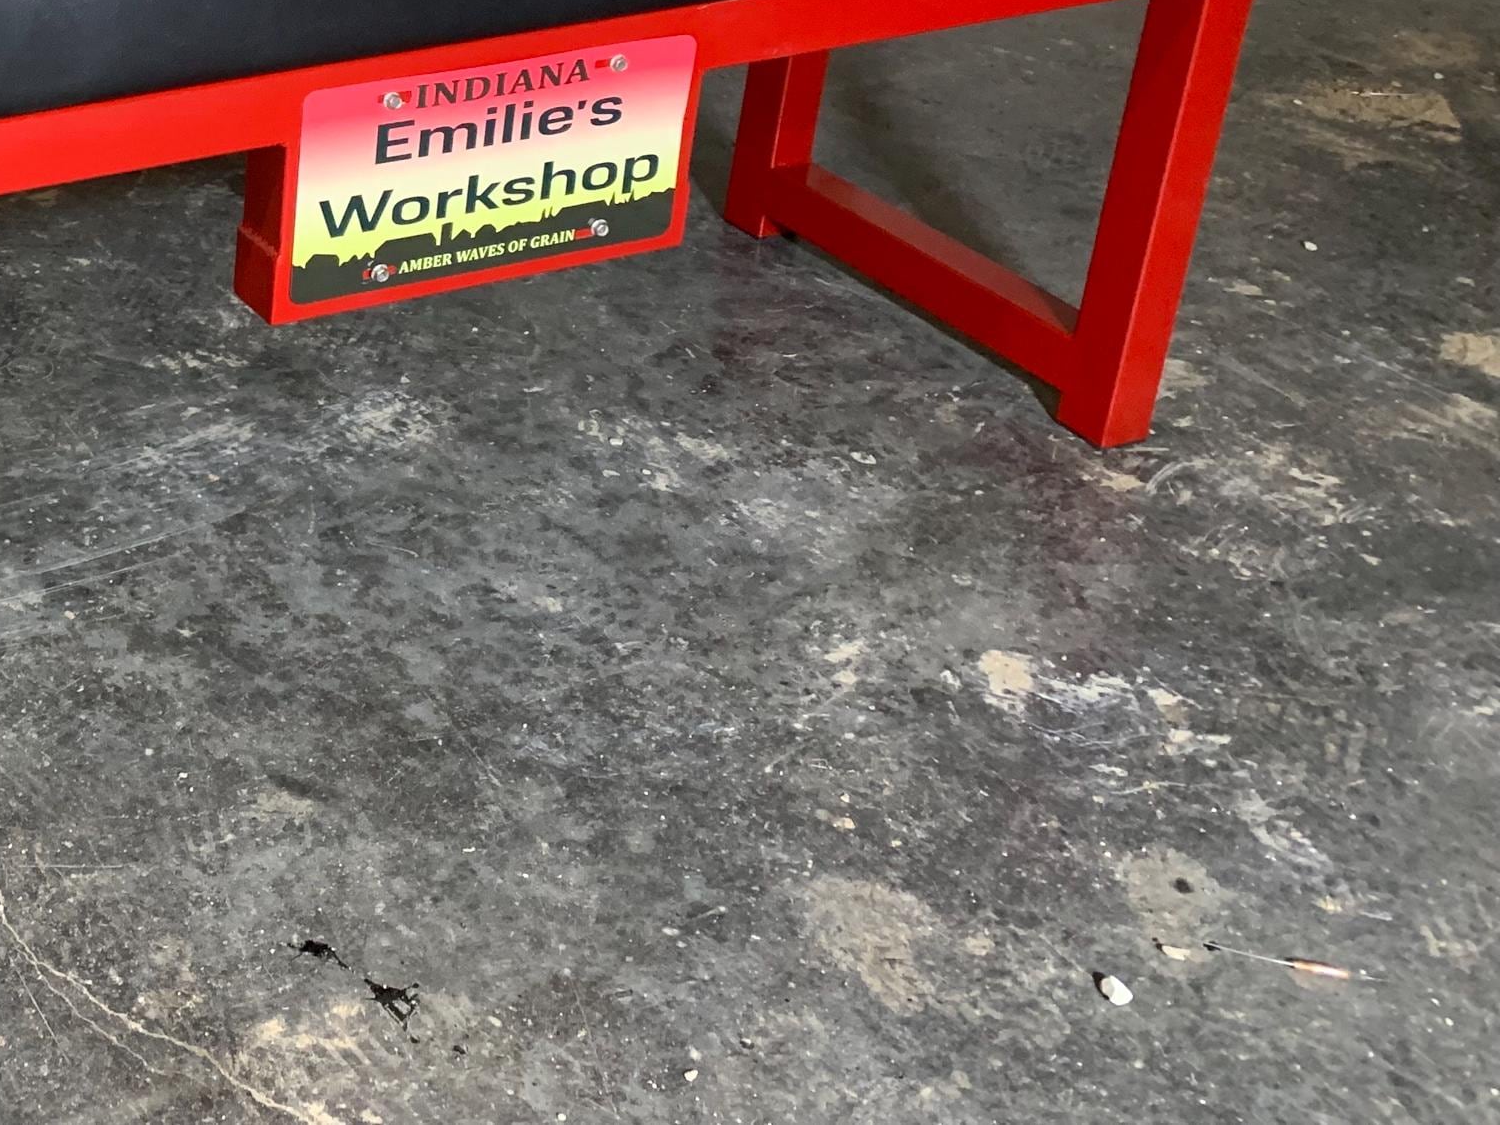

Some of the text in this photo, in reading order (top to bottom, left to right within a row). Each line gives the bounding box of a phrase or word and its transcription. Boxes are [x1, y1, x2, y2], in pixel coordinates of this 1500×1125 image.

[416, 58, 590, 109] INDIANA
[375, 95, 623, 165] Emilie's
[318, 153, 660, 238] Workshop
[398, 228, 576, 275] AMBER WAVES OF GRAIN
